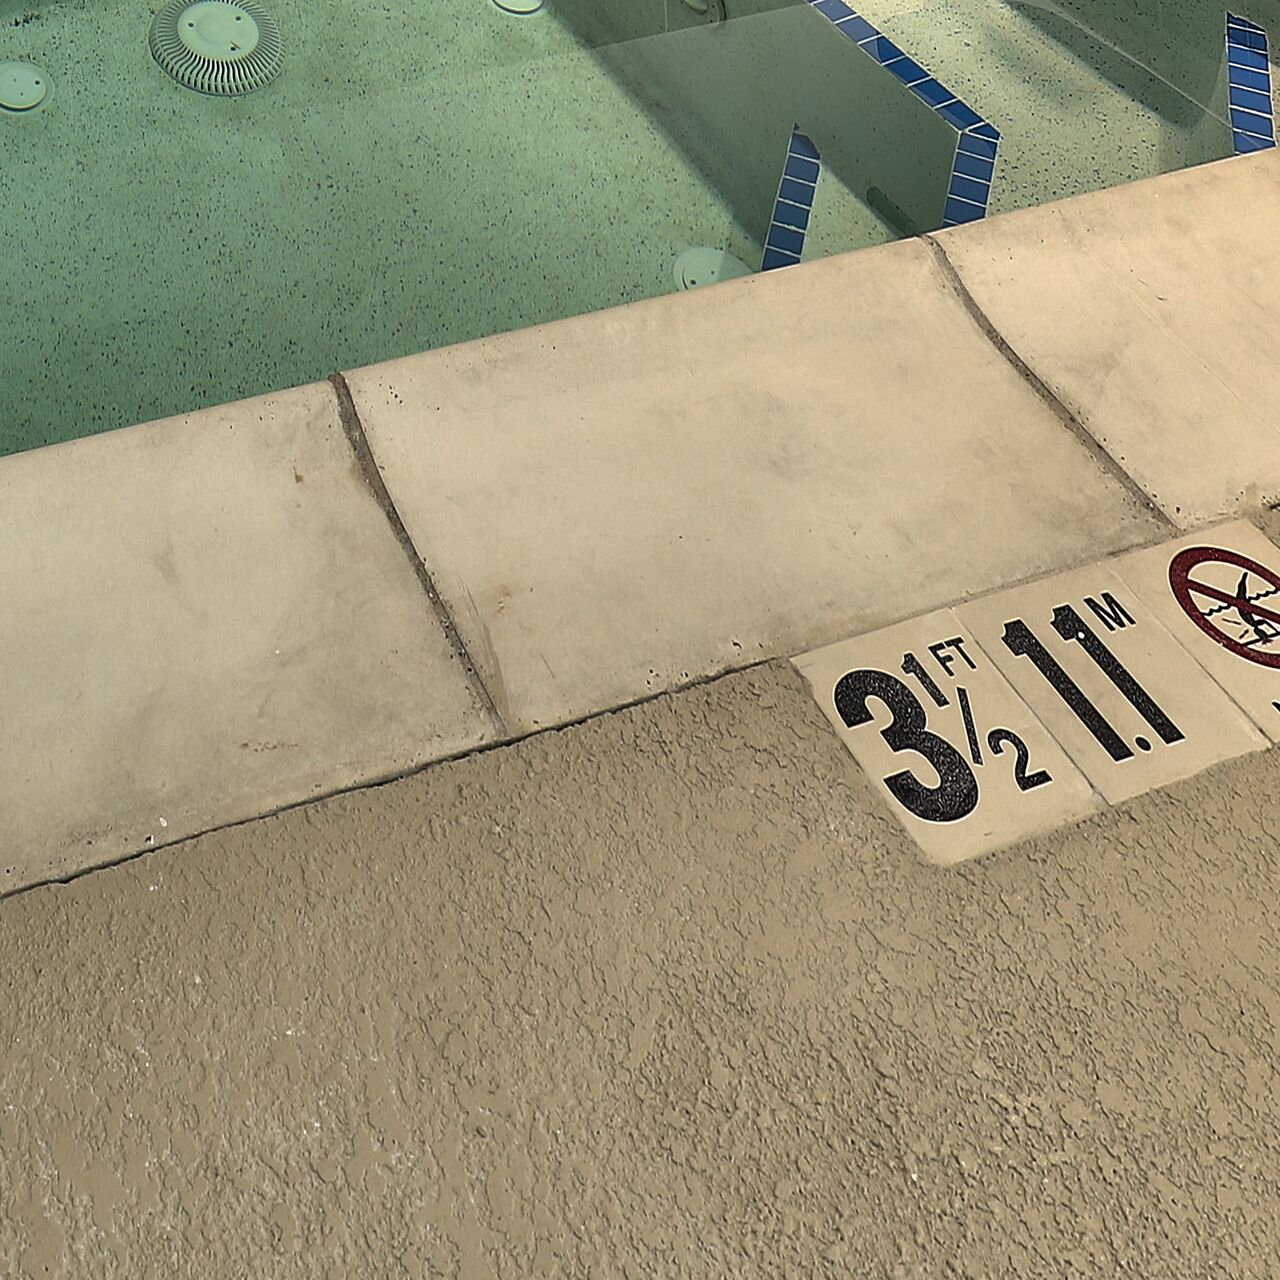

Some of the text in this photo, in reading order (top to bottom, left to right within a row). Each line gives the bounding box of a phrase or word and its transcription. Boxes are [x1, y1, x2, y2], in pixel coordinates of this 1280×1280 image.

[1083, 589, 1137, 634] M
[927, 634, 980, 678] FT
[999, 604, 1186, 763] 1.1
